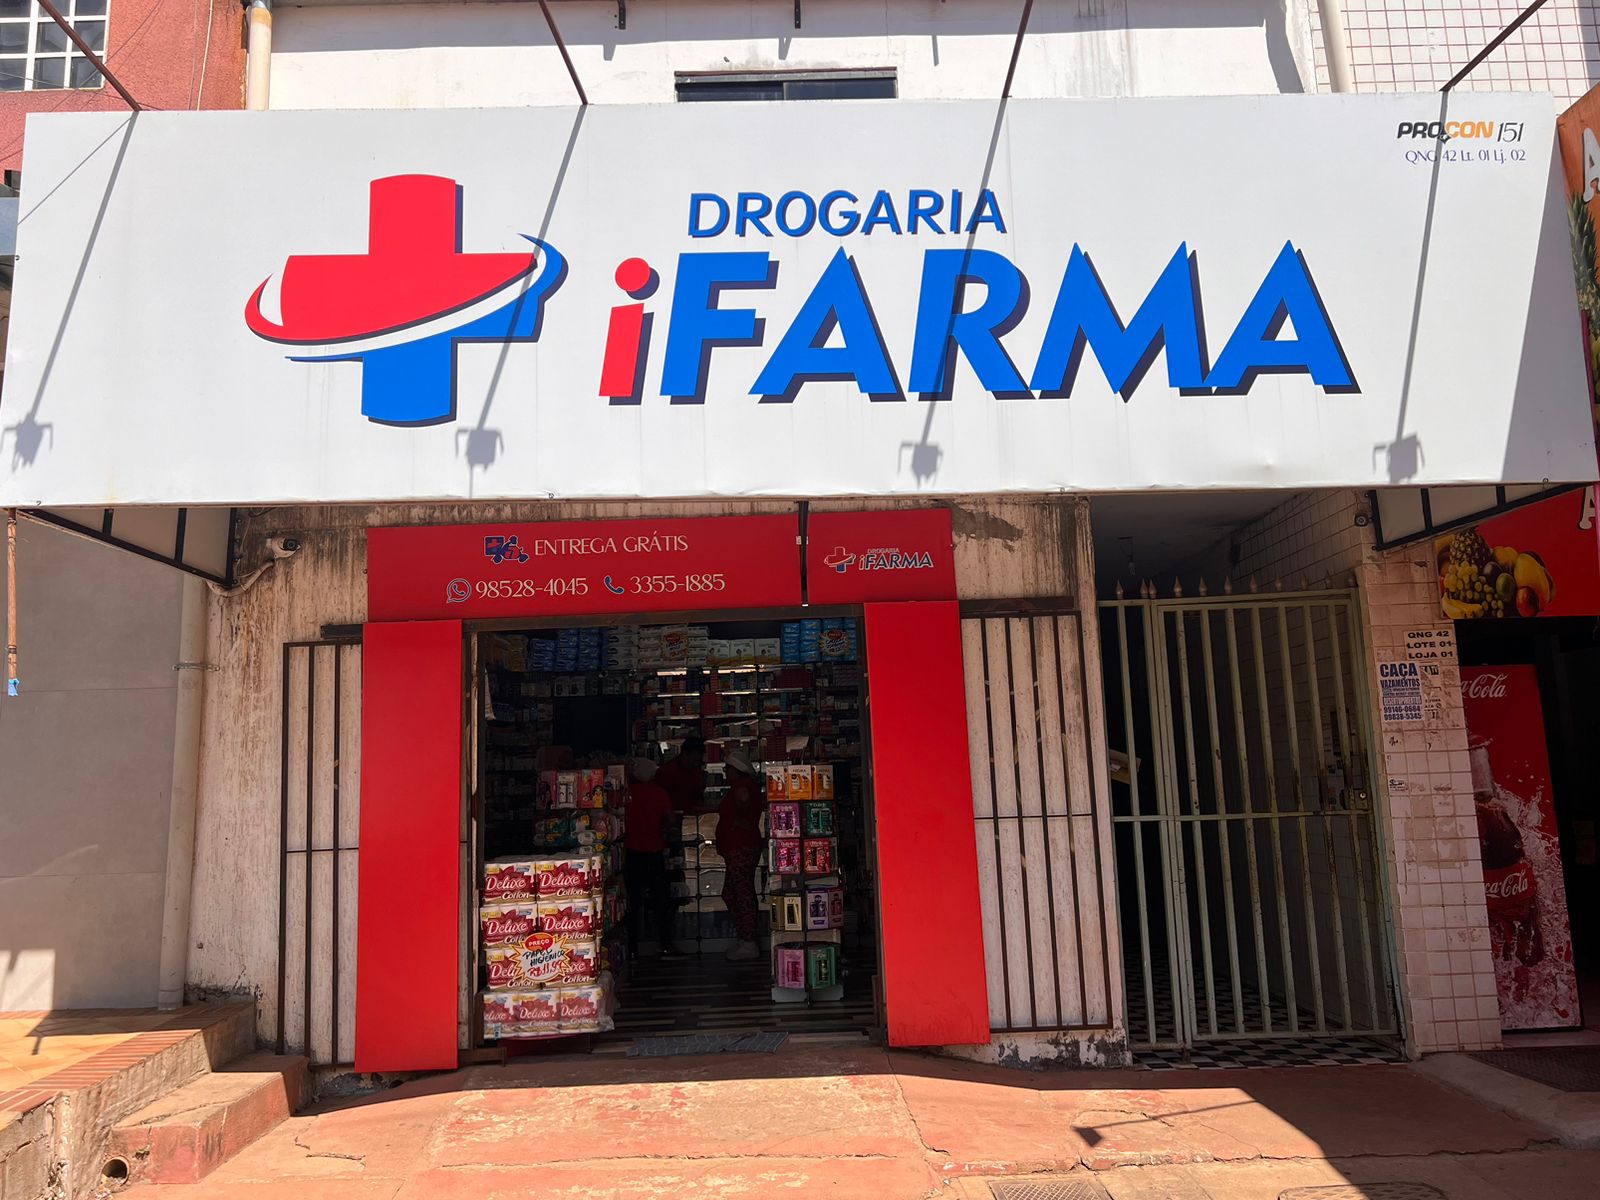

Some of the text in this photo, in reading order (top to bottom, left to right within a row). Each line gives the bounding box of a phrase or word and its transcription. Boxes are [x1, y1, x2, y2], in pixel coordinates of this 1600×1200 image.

[1396, 121, 1524, 142] PROCON 151
[1405, 149, 1526, 165] QNG 42 Lt. 01 Lj. 02
[687, 187, 1008, 238] DROGARIA
[599, 239, 1362, 405] iFARMA
[534, 530, 689, 556] ENTREGA GRÁTIS
[858, 551, 934, 571] iFARMA
[475, 576, 589, 599] 98528-4045
[629, 573, 726, 594] 3355-1885
[1408, 631, 1433, 639] QNG
[1407, 641, 1436, 649] LOTE
[1380, 663, 1418, 680] CAÇA
[1380, 678, 1421, 689] VAZAMENTOS
[486, 873, 526, 891] Deluxe
[538, 870, 581, 887] Deluxe
[487, 920, 528, 936] Deluxe
[543, 916, 585, 932] Deluxe
[528, 938, 550, 948] PREÇO
[520, 1008, 551, 1020] Deluxe
[561, 1004, 591, 1017] Deluxe
